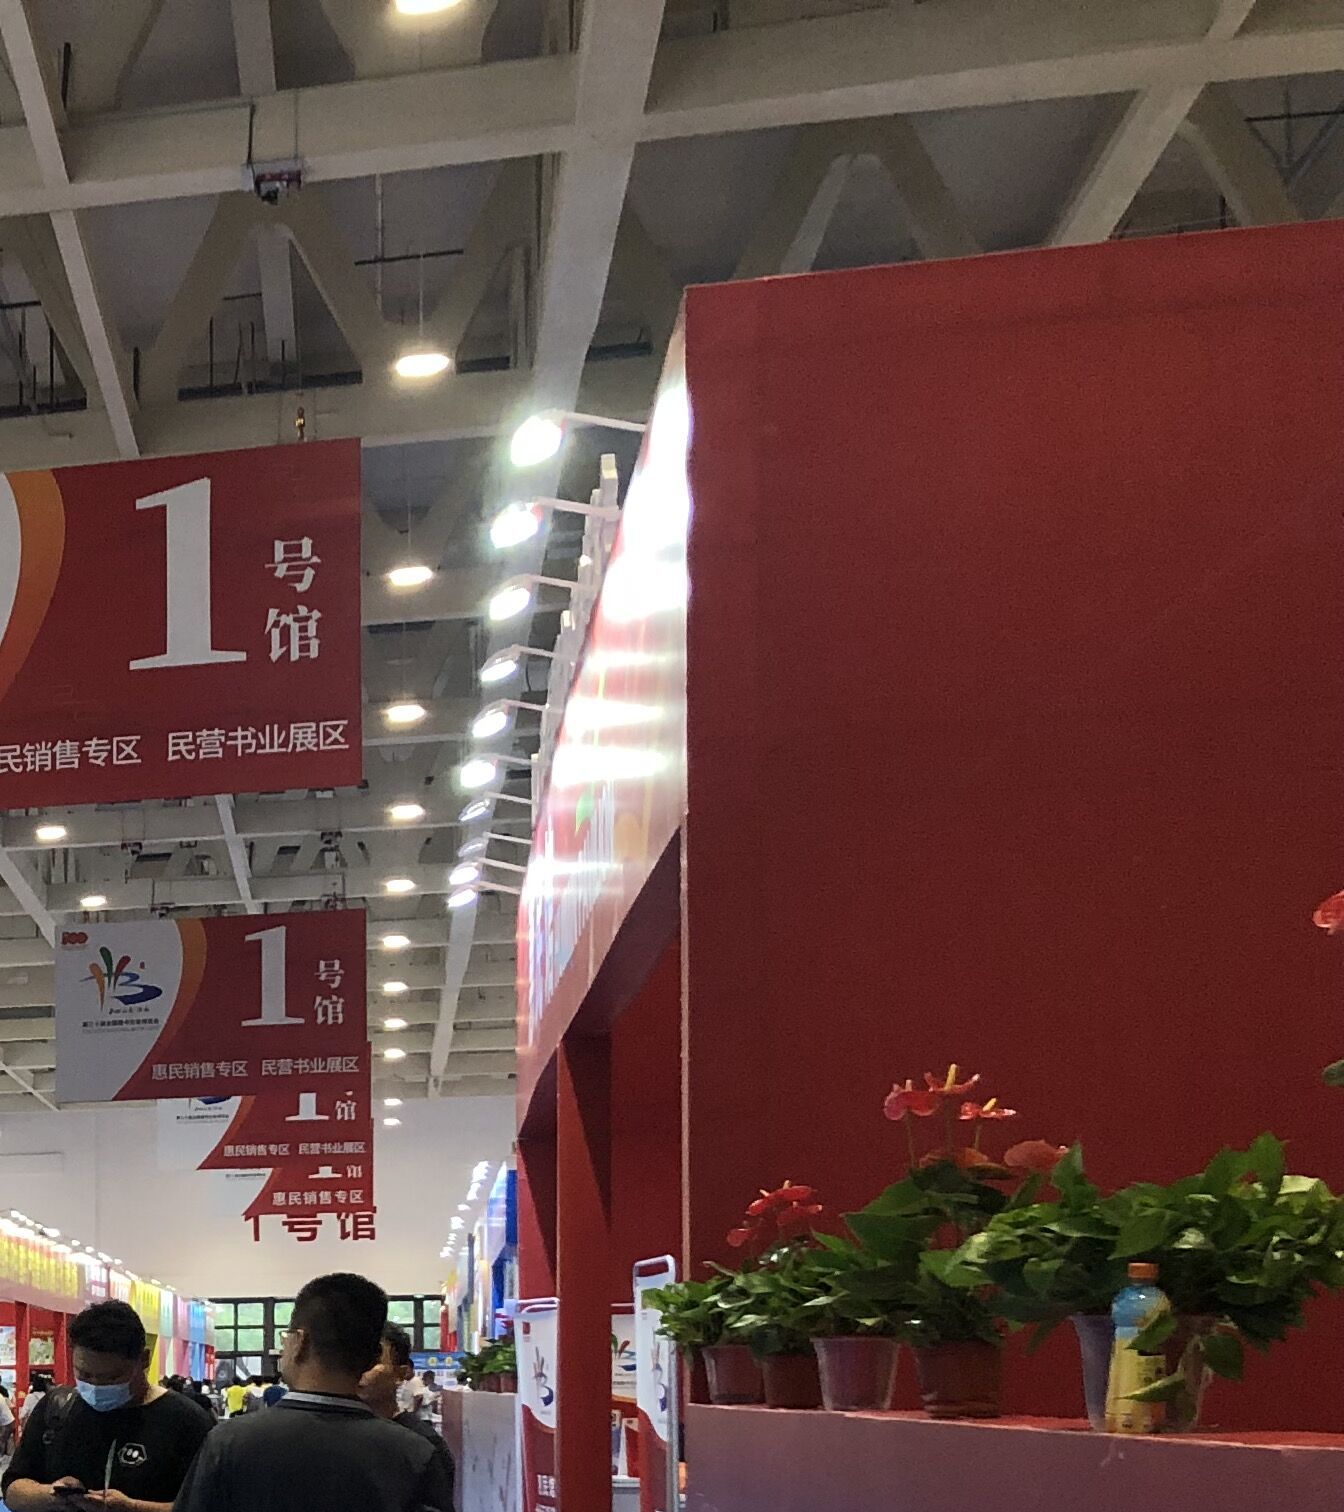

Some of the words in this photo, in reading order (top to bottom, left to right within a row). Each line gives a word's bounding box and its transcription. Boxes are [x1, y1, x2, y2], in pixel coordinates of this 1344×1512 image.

[128, 475, 247, 671] 1
[264, 536, 322, 664] 号馆
[167, 719, 350, 761] 民营书业展区
[241, 925, 305, 1027] 1
[313, 958, 345, 1026] 号馆
[151, 1060, 249, 1080] 惠民销售专区
[261, 1056, 360, 1076] 民营书业展区
[223, 1144, 290, 1157] 惠民销售专区
[298, 1142, 367, 1155] 民营书业展区
[271, 1190, 365, 1206] 惠民销售专区
